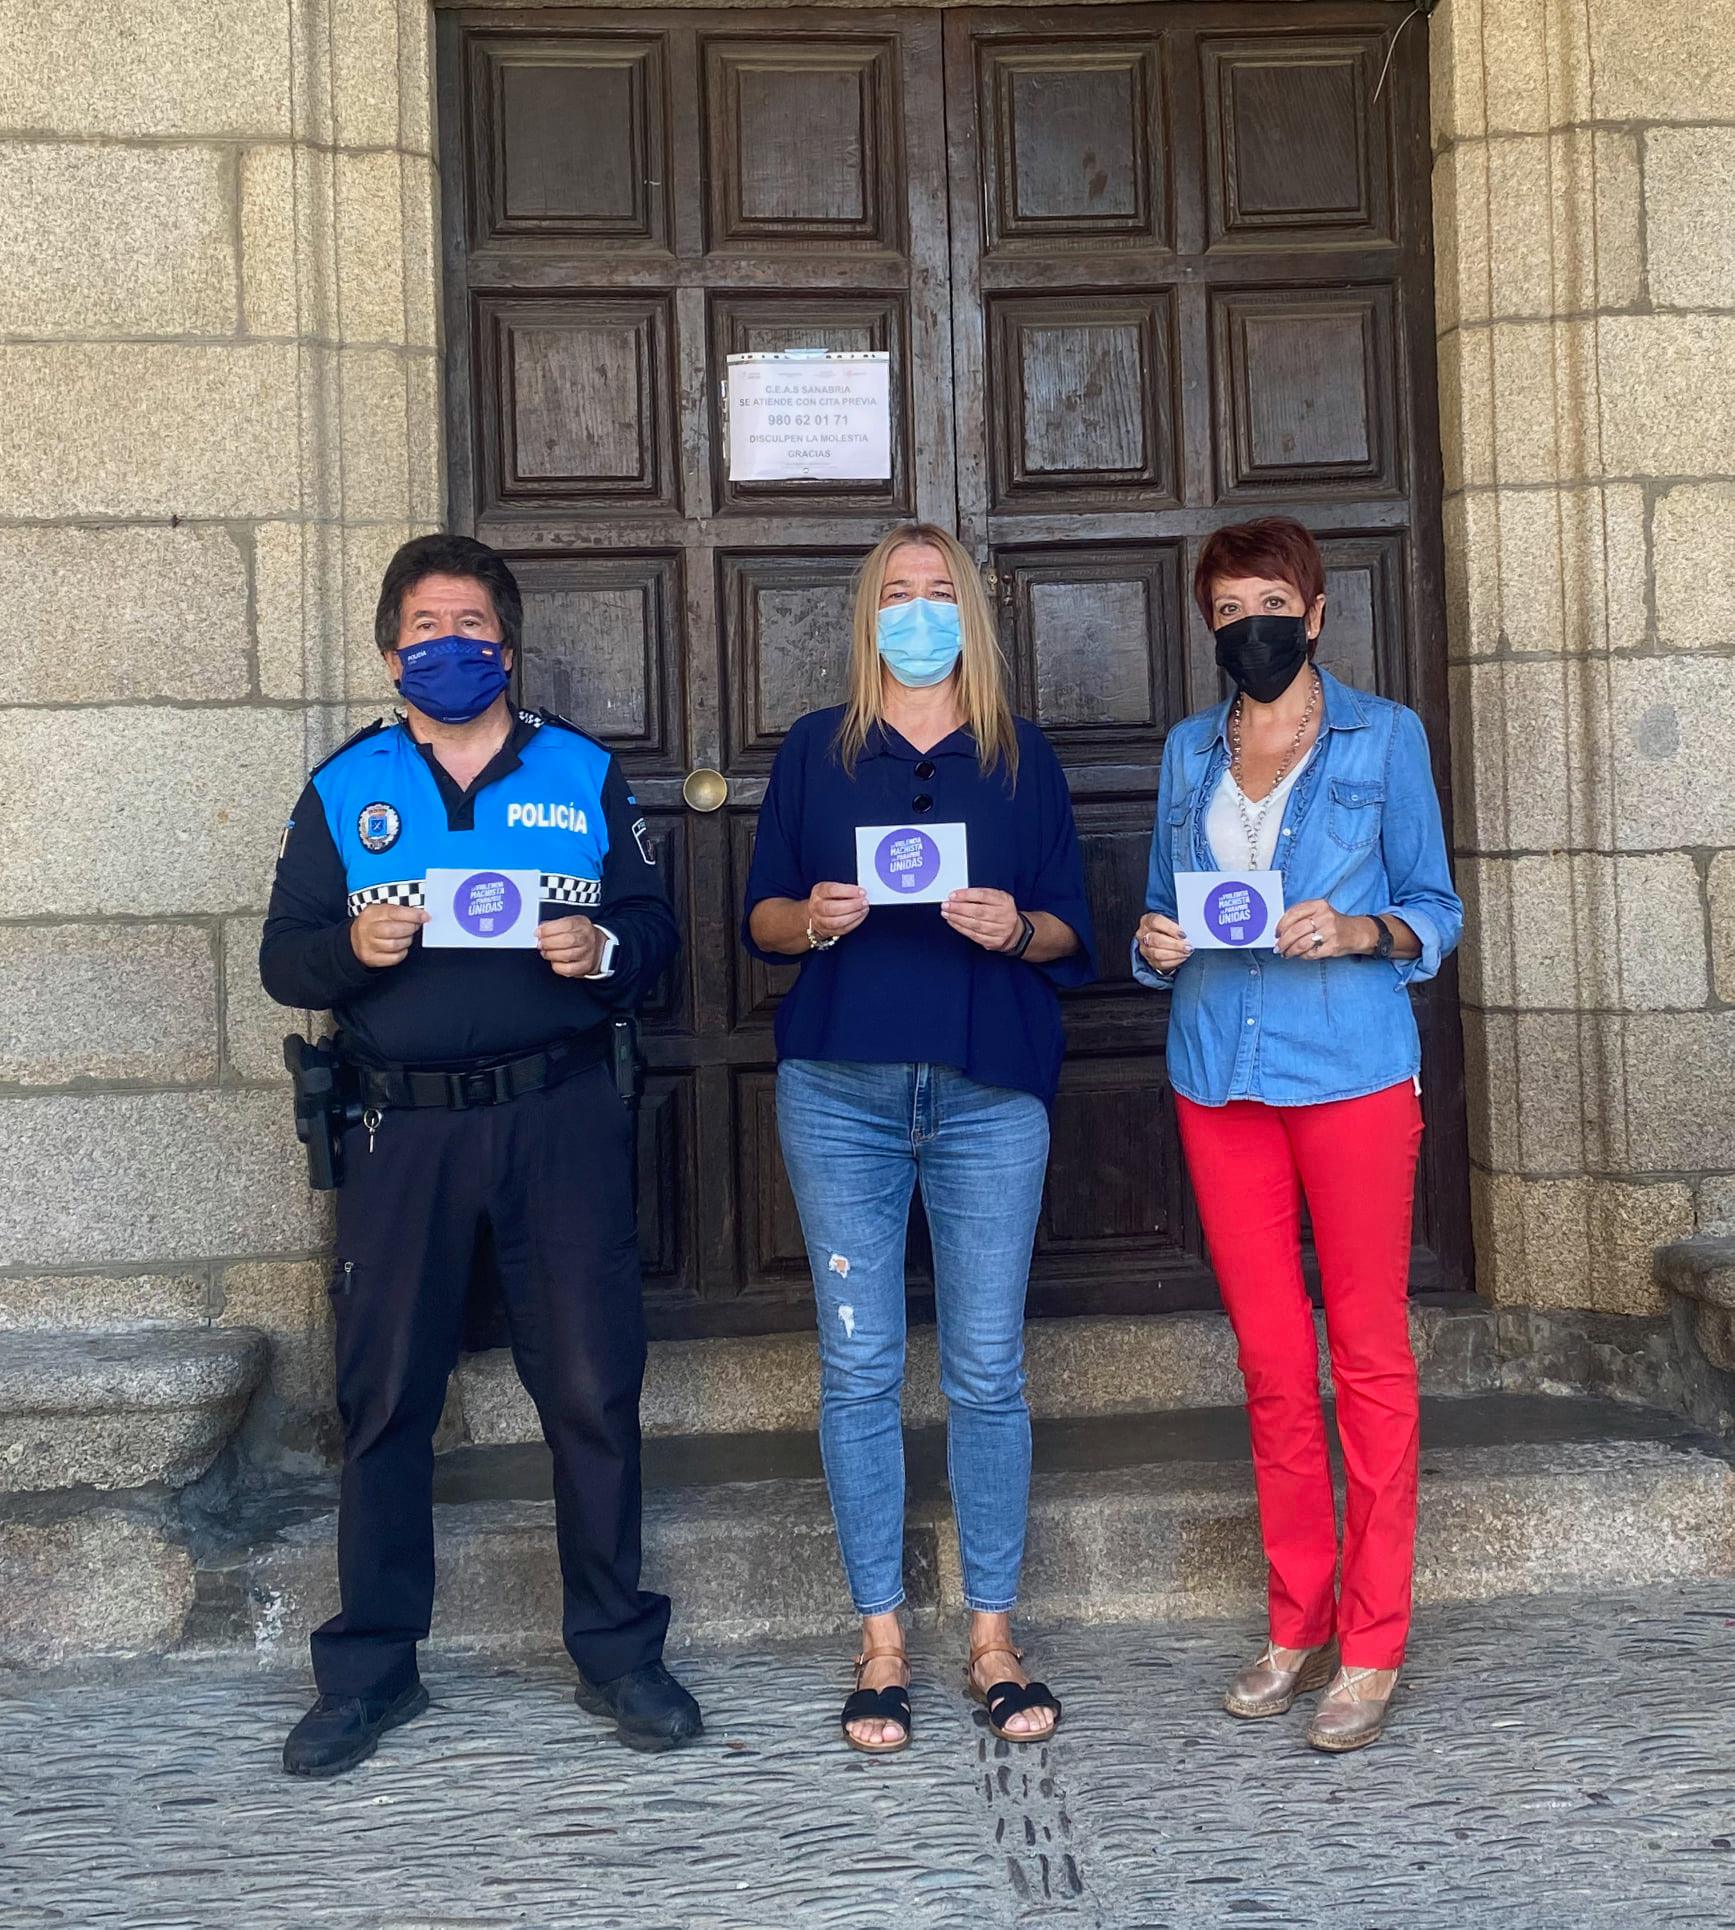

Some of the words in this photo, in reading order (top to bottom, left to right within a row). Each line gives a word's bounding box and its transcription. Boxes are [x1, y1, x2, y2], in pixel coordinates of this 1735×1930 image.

[802, 385, 851, 394] SANABRIA
[739, 398, 750, 407] SE
[753, 398, 793, 407] ATIENDE
[796, 398, 817, 407] CON
[819, 398, 839, 406] CITA
[842, 397, 877, 406] PREVIA
[768, 414, 791, 426] 980
[795, 414, 811, 426] 62
[815, 414, 830, 425] 01
[834, 414, 848, 425] 71
[749, 434, 803, 444] DISCULPEN
[806, 434, 818, 443] LA
[820, 433, 869, 443] MOLESTIA
[788, 449, 831, 458] GRACIAS
[507, 802, 588, 834] POLICÍA
[890, 856, 923, 872] UNIDAS
[468, 901, 503, 916] UNIDAS
[1218, 909, 1251, 925] UNIDAS
